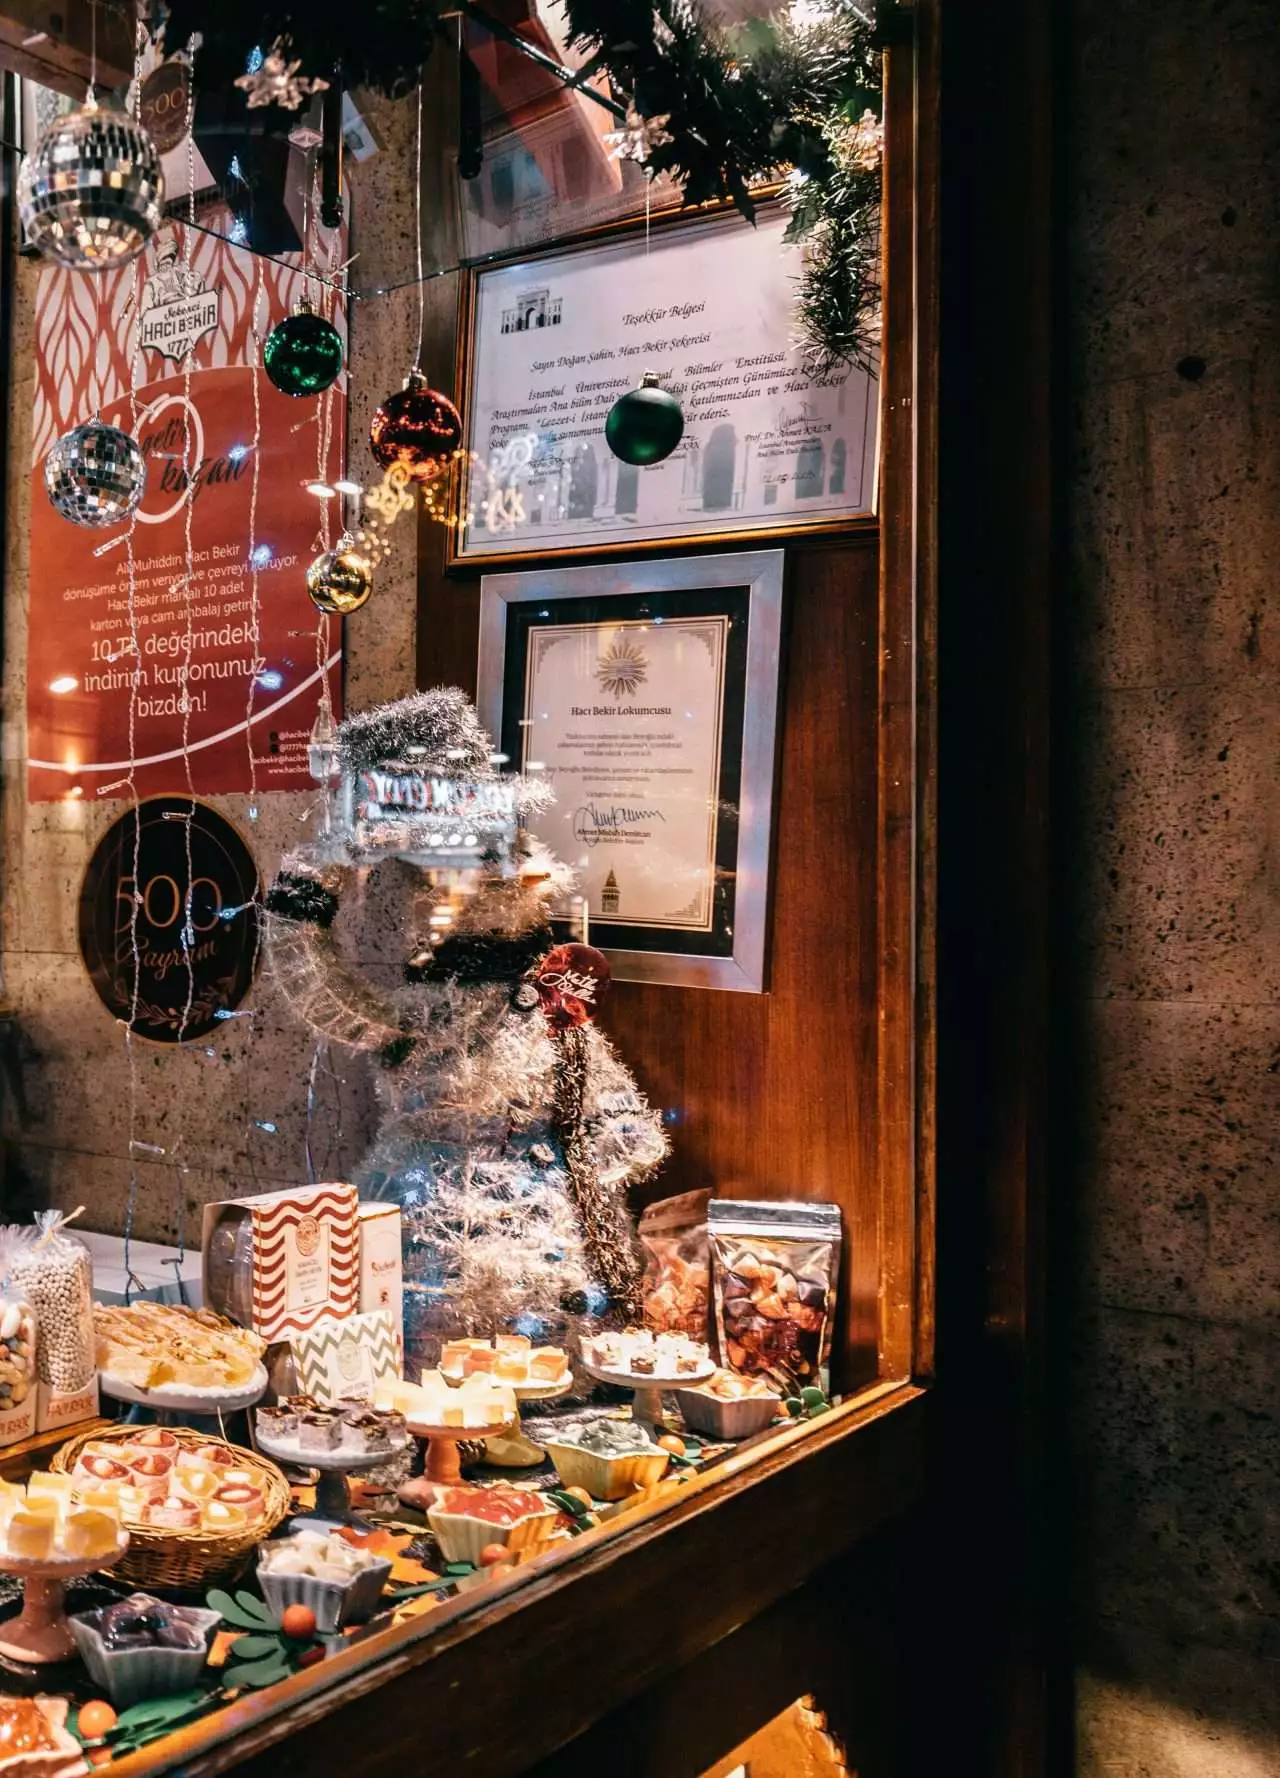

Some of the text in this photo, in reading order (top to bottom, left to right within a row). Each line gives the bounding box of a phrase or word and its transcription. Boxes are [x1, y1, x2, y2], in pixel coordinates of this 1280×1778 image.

[622, 300, 707, 326] Teşekkür Belgesi
[143, 321, 176, 342] HACI
[212, 543, 241, 559] Bekir
[203, 583, 217, 597] 10
[219, 580, 245, 594] adet
[151, 610, 175, 623] cam
[90, 639, 112, 662] 10
[144, 620, 261, 658] değerindeki
[84, 656, 268, 692] indirim kuponunuz
[136, 689, 208, 718] bizden!
[571, 705, 672, 717] Hacı Bekir Lokumcusu
